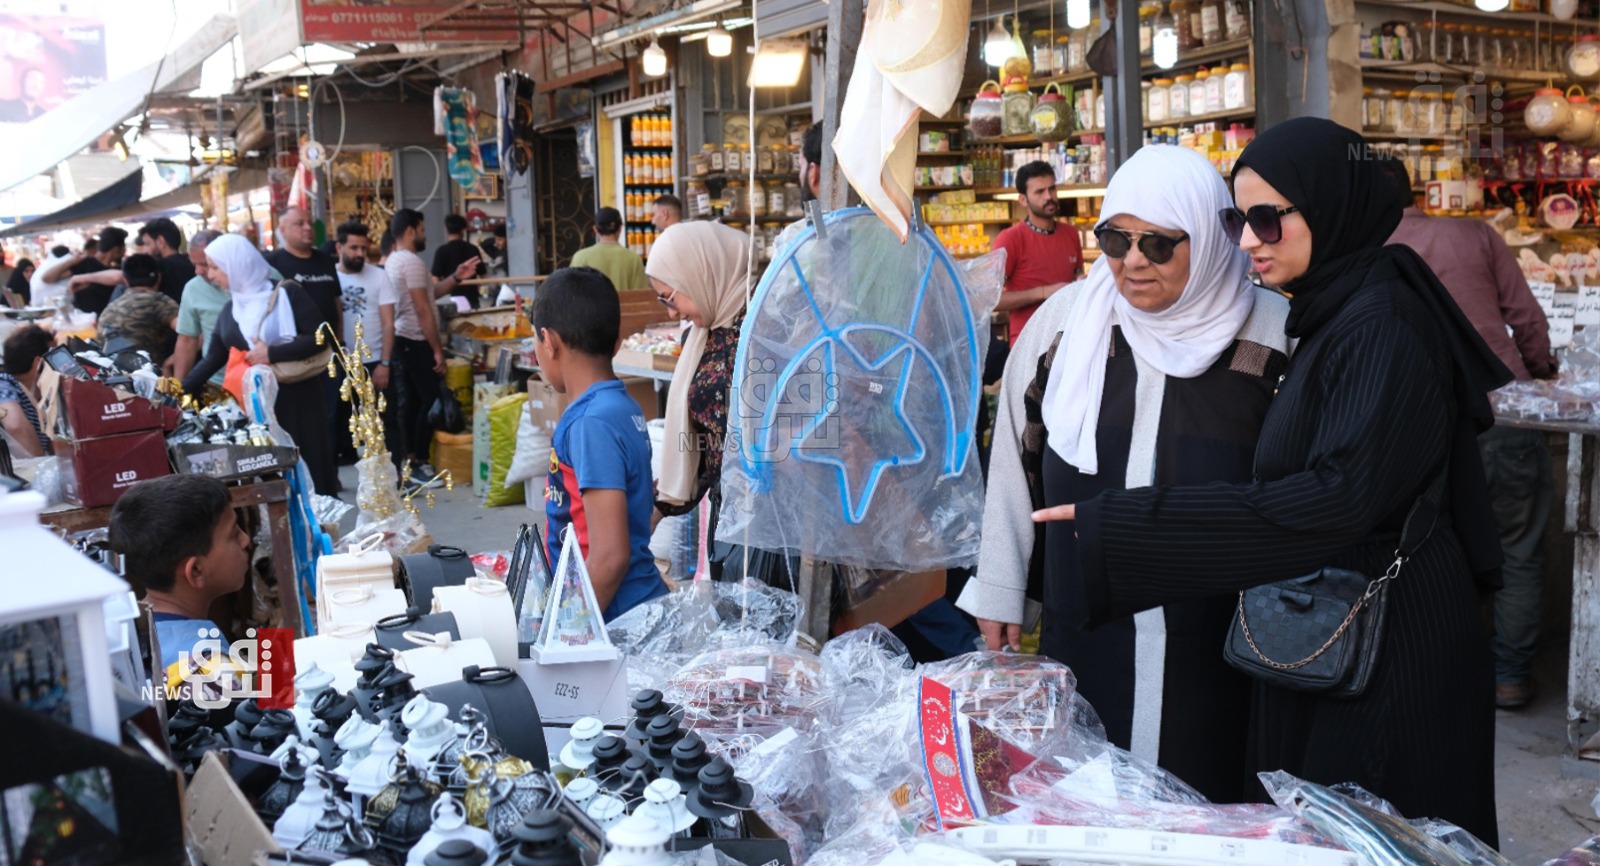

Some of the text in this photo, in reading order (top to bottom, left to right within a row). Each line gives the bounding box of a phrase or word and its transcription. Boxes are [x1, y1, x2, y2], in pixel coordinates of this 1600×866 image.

[104, 402, 126, 414] LED
[236, 453, 273, 466] SIMULATED
[237, 458, 278, 473] LED CANDLE
[115, 470, 137, 482] LED
